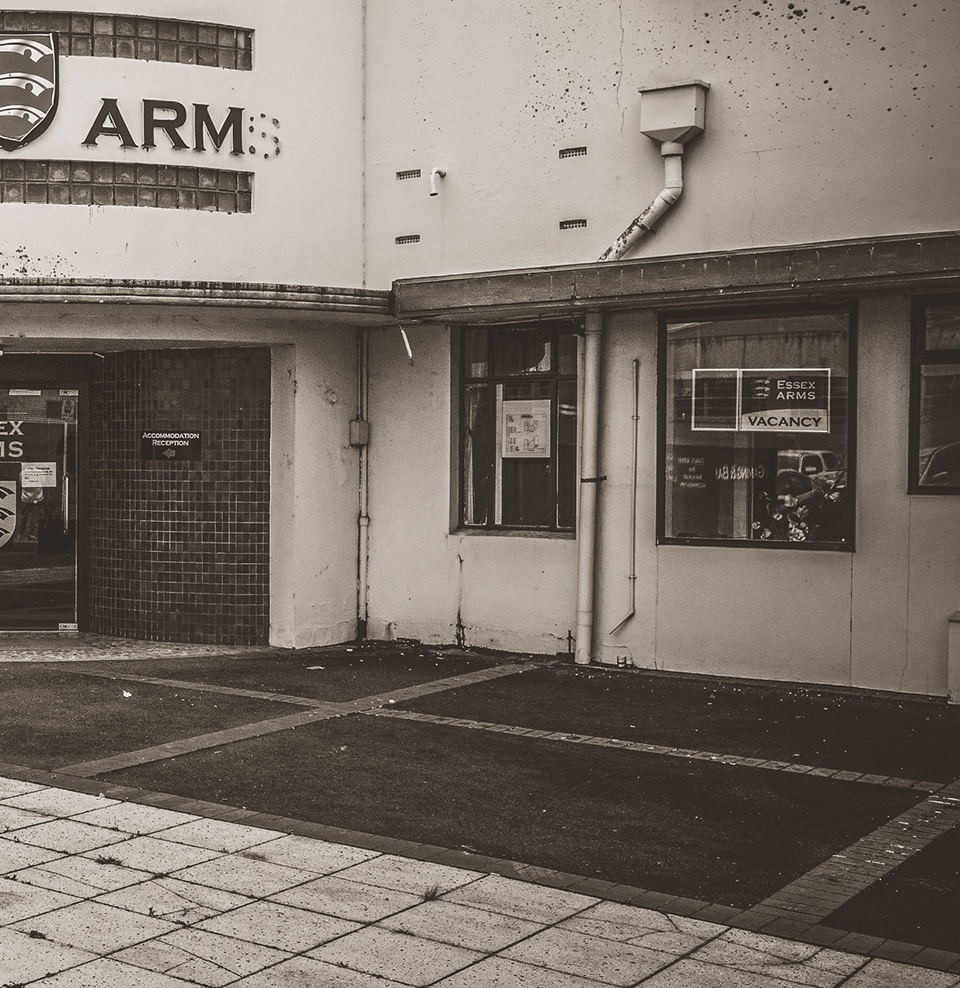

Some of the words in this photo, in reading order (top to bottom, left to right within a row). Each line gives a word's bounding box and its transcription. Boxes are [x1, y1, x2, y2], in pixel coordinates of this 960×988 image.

[777, 380, 816, 390] ESSEX
[776, 391, 816, 400] ARMS
[748, 416, 822, 428] VACANCY
